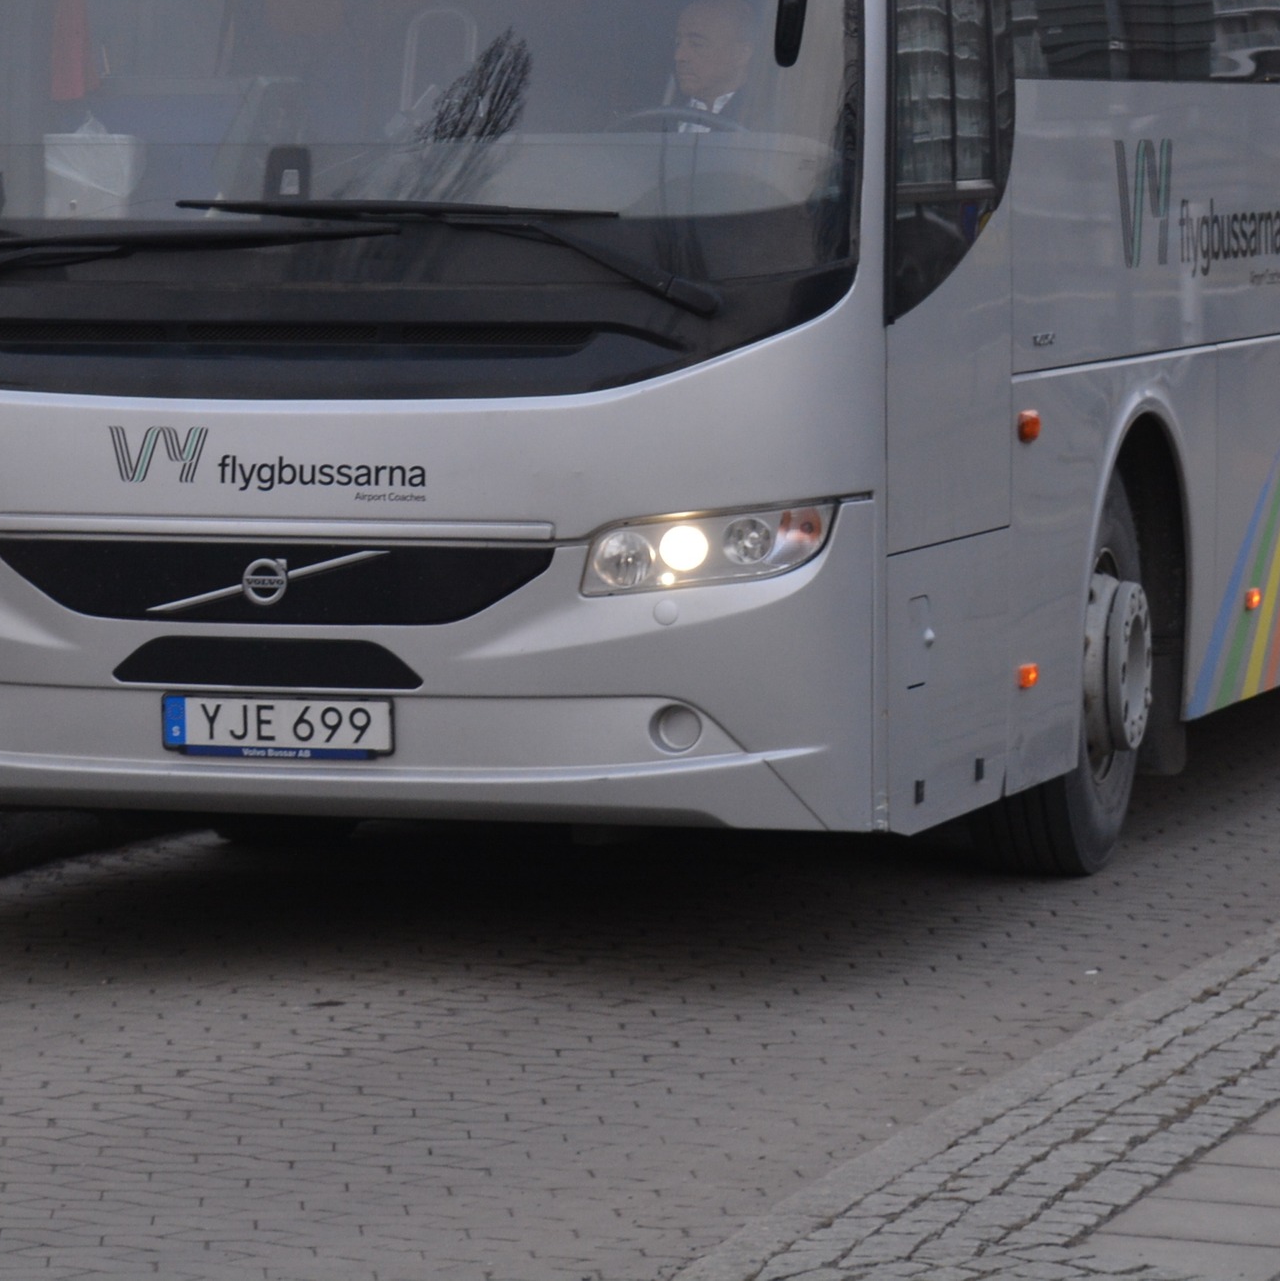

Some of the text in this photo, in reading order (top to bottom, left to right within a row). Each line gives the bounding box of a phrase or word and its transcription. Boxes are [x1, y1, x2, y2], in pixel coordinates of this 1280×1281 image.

[218, 455, 427, 491] flygbussarna
[354, 492, 426, 502] Airport Coaches
[201, 704, 371, 744] YJE 699
[242, 748, 266, 757] Volvo
[297, 749, 311, 758] AB
